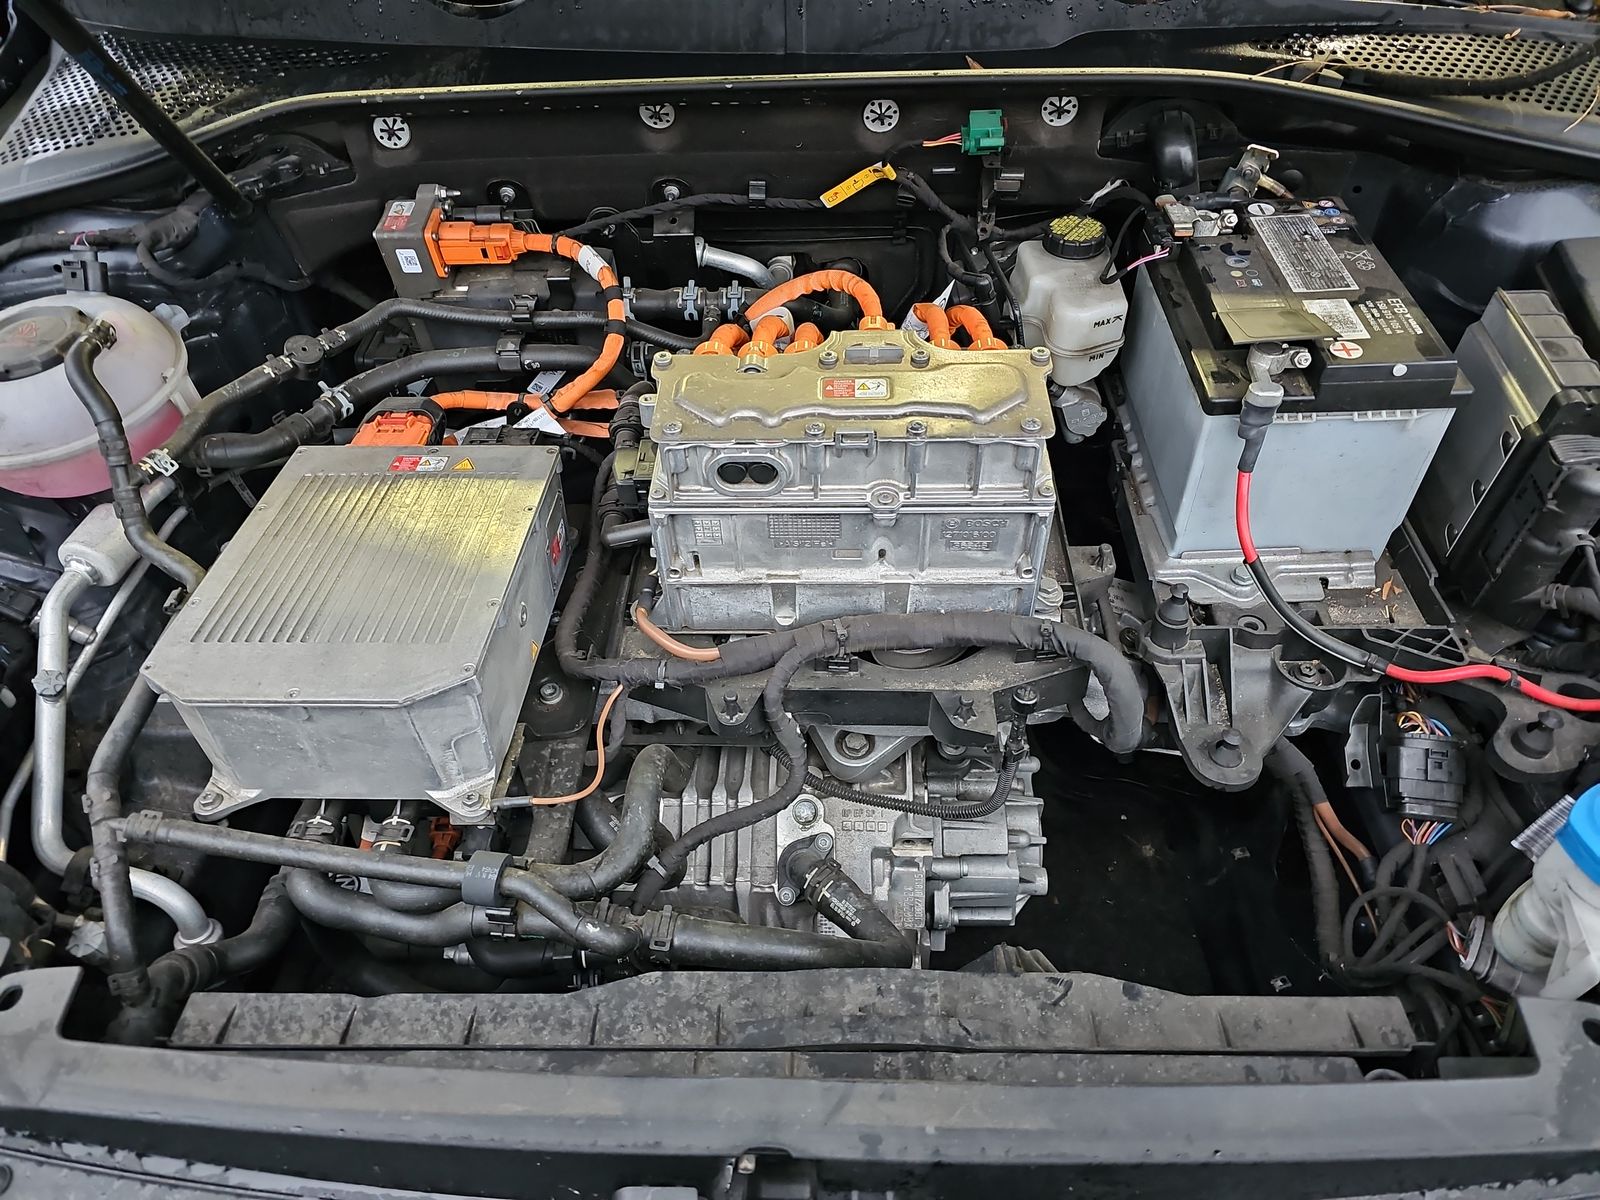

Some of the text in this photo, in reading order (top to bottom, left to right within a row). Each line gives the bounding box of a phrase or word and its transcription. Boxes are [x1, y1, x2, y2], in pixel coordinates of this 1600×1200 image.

[1387, 298, 1409, 314] EFB
[1093, 317, 1111, 328] MAX
[1088, 352, 1104, 362] MIN
[965, 518, 1010, 529] BOSCH
